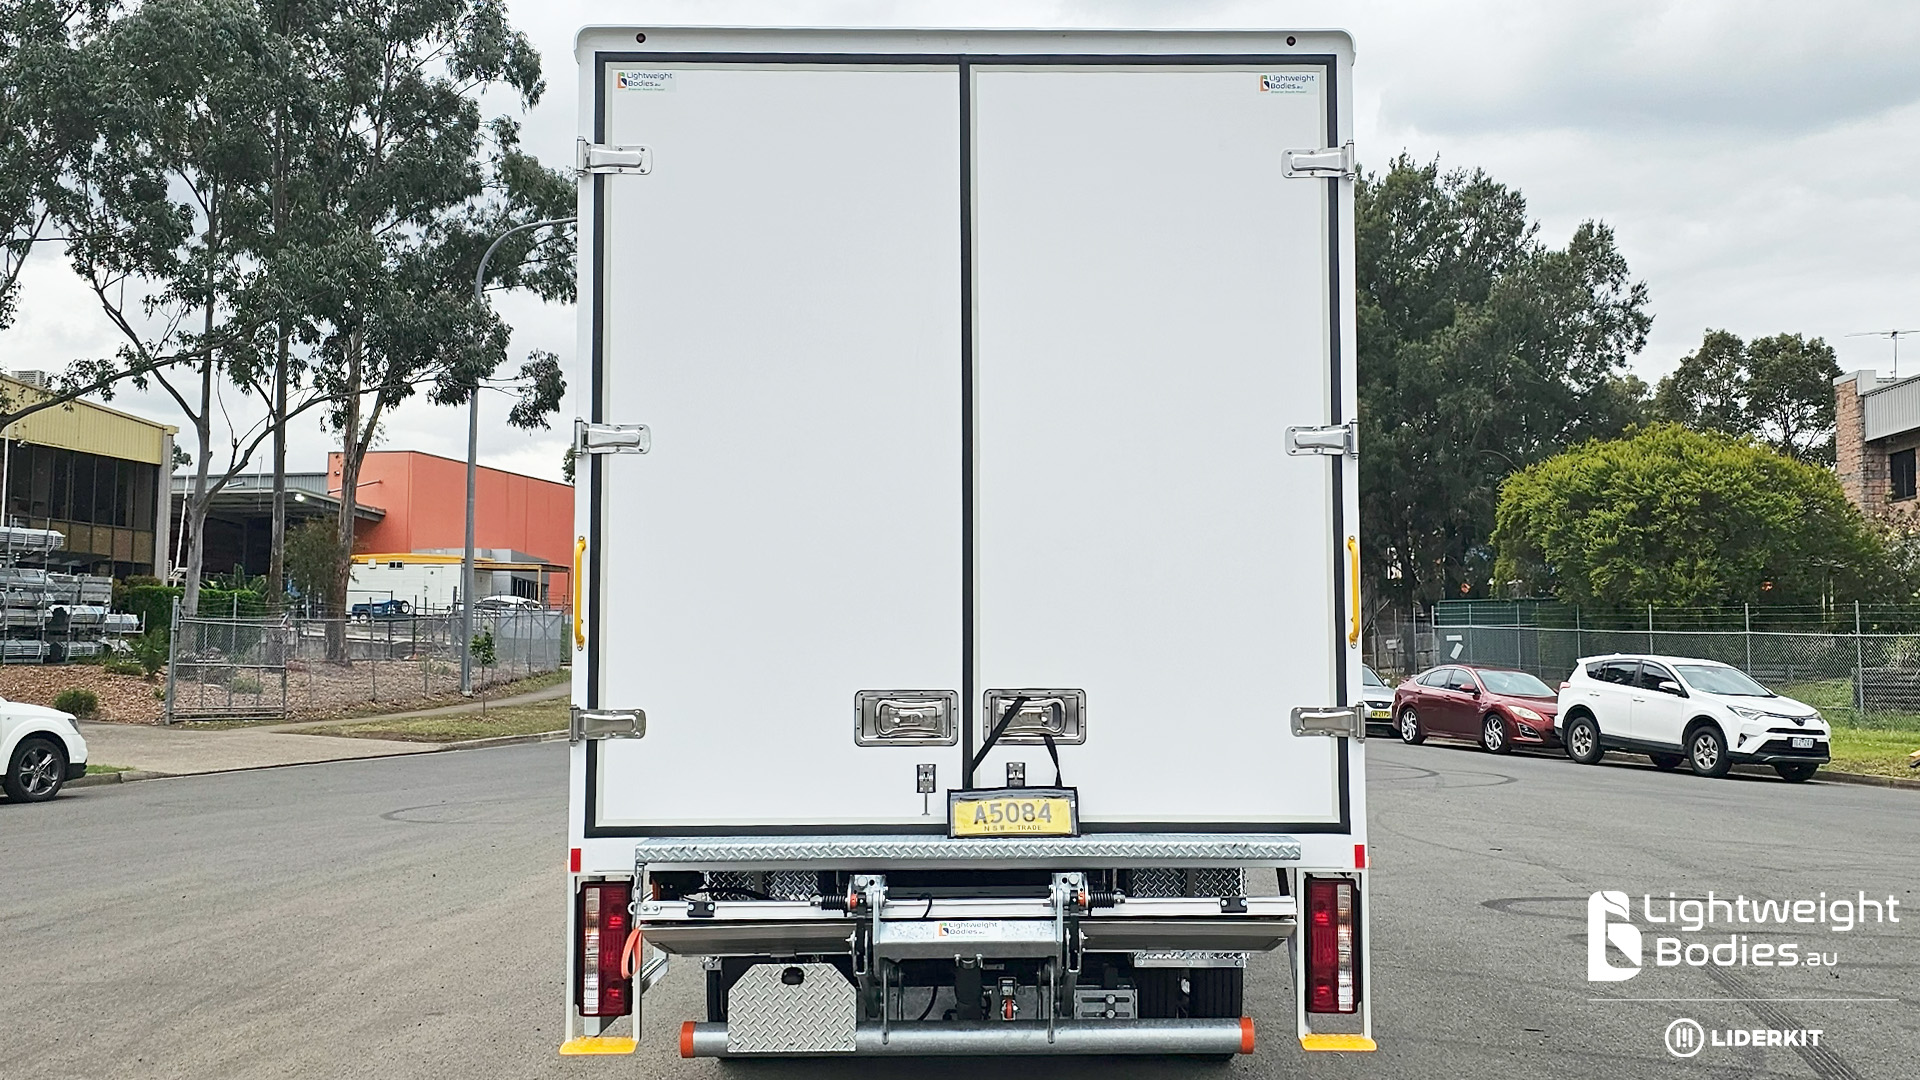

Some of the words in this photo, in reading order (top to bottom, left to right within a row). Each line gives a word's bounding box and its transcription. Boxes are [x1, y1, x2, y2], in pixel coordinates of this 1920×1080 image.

[626, 72, 673, 80] Lightweight
[1269, 75, 1315, 83] Lightweight
[973, 802, 1052, 825] A5084
